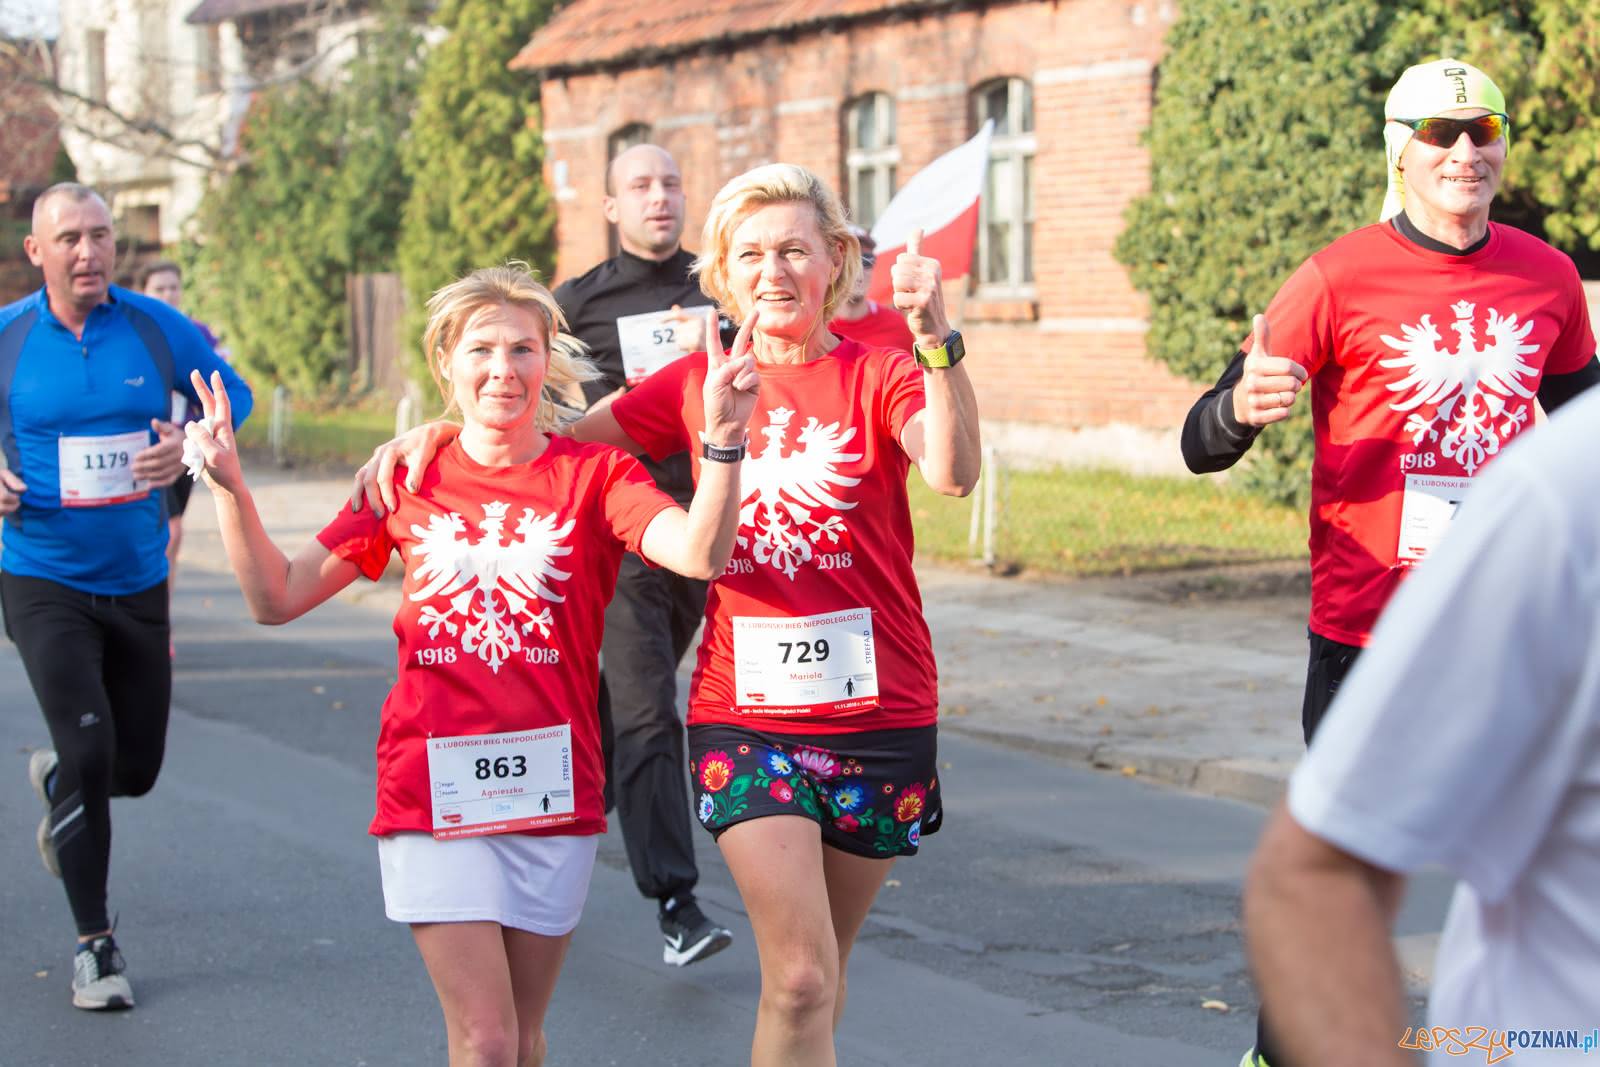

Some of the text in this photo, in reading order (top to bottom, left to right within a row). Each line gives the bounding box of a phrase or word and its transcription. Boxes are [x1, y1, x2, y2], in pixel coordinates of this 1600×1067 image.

[652, 328, 675, 345] 52
[83, 451, 129, 470] 1179
[1399, 452, 1436, 470] 1918
[1421, 479, 1458, 488] LUBOŃSKI
[814, 552, 853, 570] 2018
[804, 613, 864, 628] NIEPODLEGŁOŚCI
[415, 647, 559, 665] 1918 2018
[777, 639, 830, 664] 729
[789, 672, 823, 681] Mariola
[443, 739, 482, 749] LUBOŃSKI
[483, 738, 501, 746] BIEG
[502, 730, 564, 744] NIEPODLEGŁOŚCI
[475, 755, 527, 780] 863
[562, 754, 570, 781] STREFA
[481, 787, 524, 799] Agnieszka
